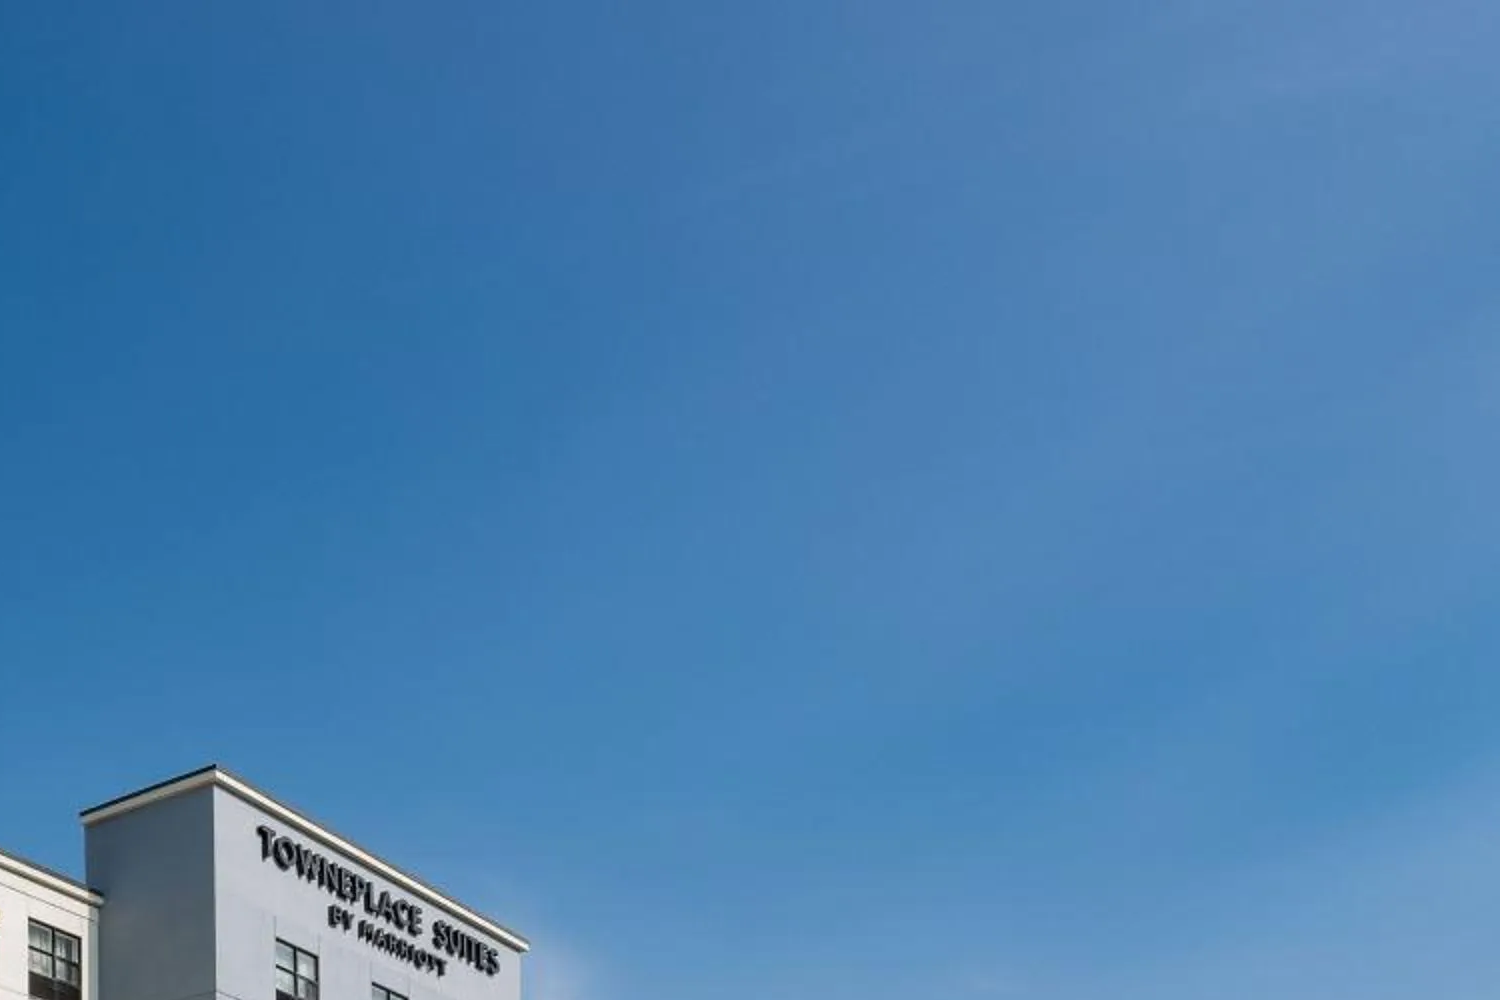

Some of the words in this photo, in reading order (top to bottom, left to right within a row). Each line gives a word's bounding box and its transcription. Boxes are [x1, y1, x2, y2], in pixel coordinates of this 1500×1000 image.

[256, 825, 423, 937] TOWNEPLACE
[433, 919, 500, 976] SUITES
[327, 904, 355, 932] BY
[357, 919, 448, 976] MARRIOTT
